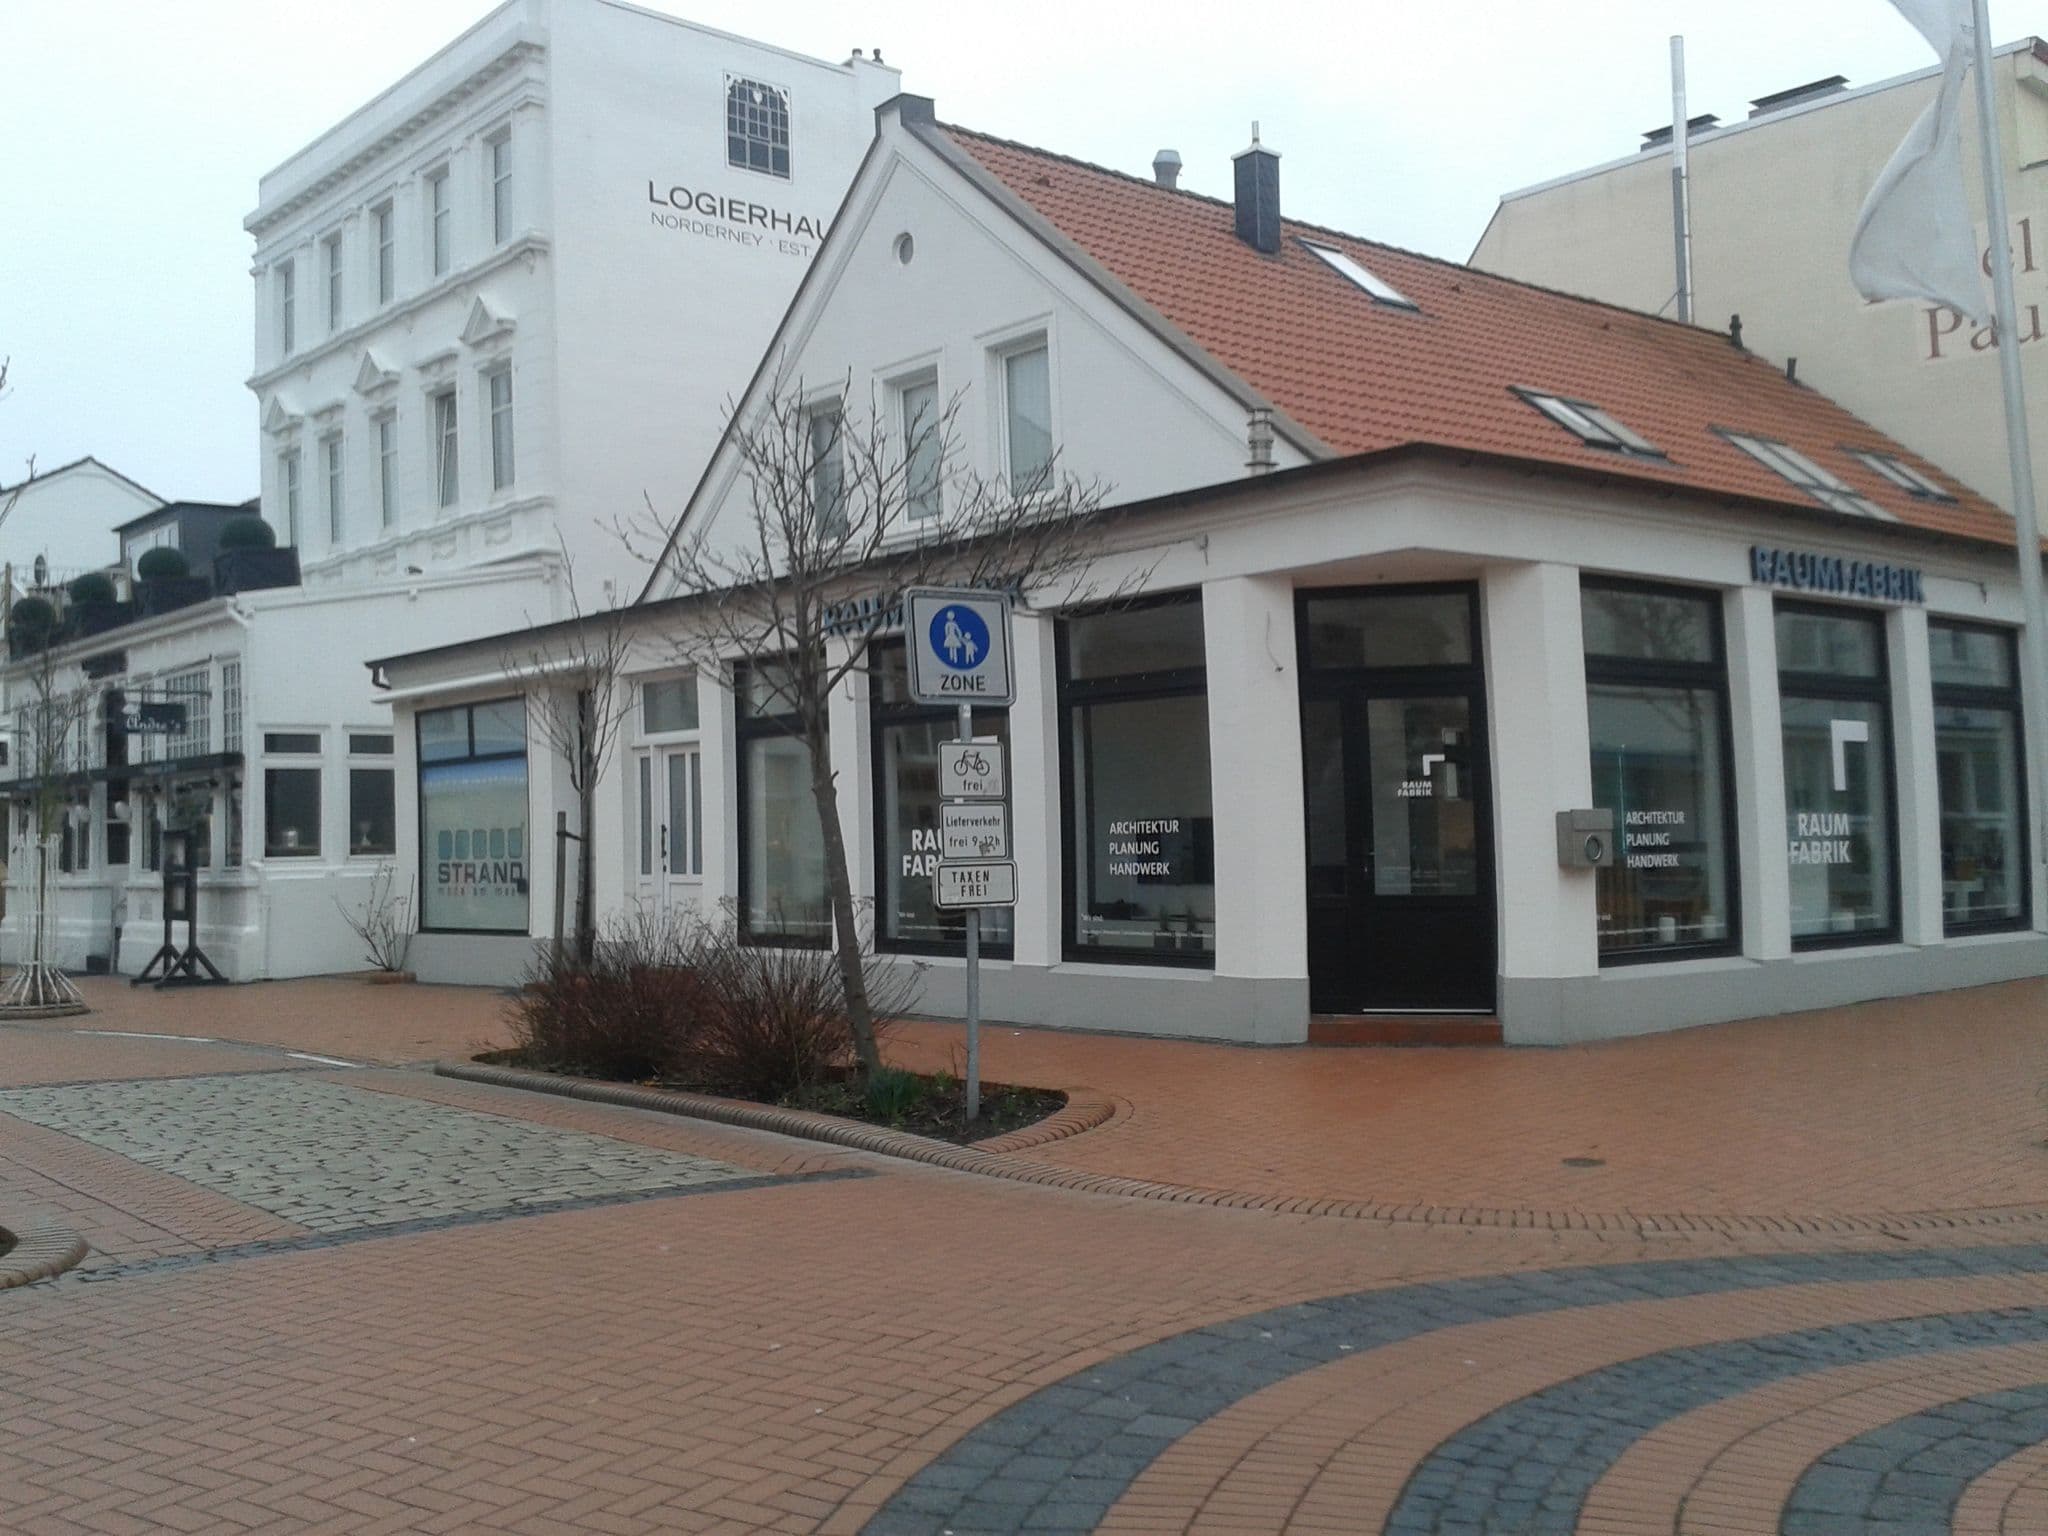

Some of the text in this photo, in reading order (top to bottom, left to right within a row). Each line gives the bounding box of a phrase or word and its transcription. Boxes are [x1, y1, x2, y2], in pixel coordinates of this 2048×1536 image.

[651, 211, 764, 247] NORDERNEY
[1750, 545, 1925, 603] RAUMFABRIK
[940, 674, 987, 693] ZONE
[962, 778, 984, 792] frei
[1396, 788, 1433, 797] FABRIK
[1401, 781, 1433, 789] RAUM
[945, 815, 1001, 828] Lieferverkehr
[1625, 810, 1685, 825] ARCHITEKTUR
[1797, 812, 1850, 837] RAUM
[1109, 819, 1180, 835] ARCHITEKTUR
[949, 835, 968, 848] frei
[1625, 832, 1670, 847] PLANUNG
[1108, 840, 1160, 855] PLANUNG
[1789, 839, 1852, 865] FABRIK
[1109, 861, 1171, 876] HANDWERK
[1626, 853, 1680, 869] HANDWERK
[438, 861, 524, 884] STRAND
[951, 870, 990, 884] TAXEN
[960, 884, 988, 897] FREI
